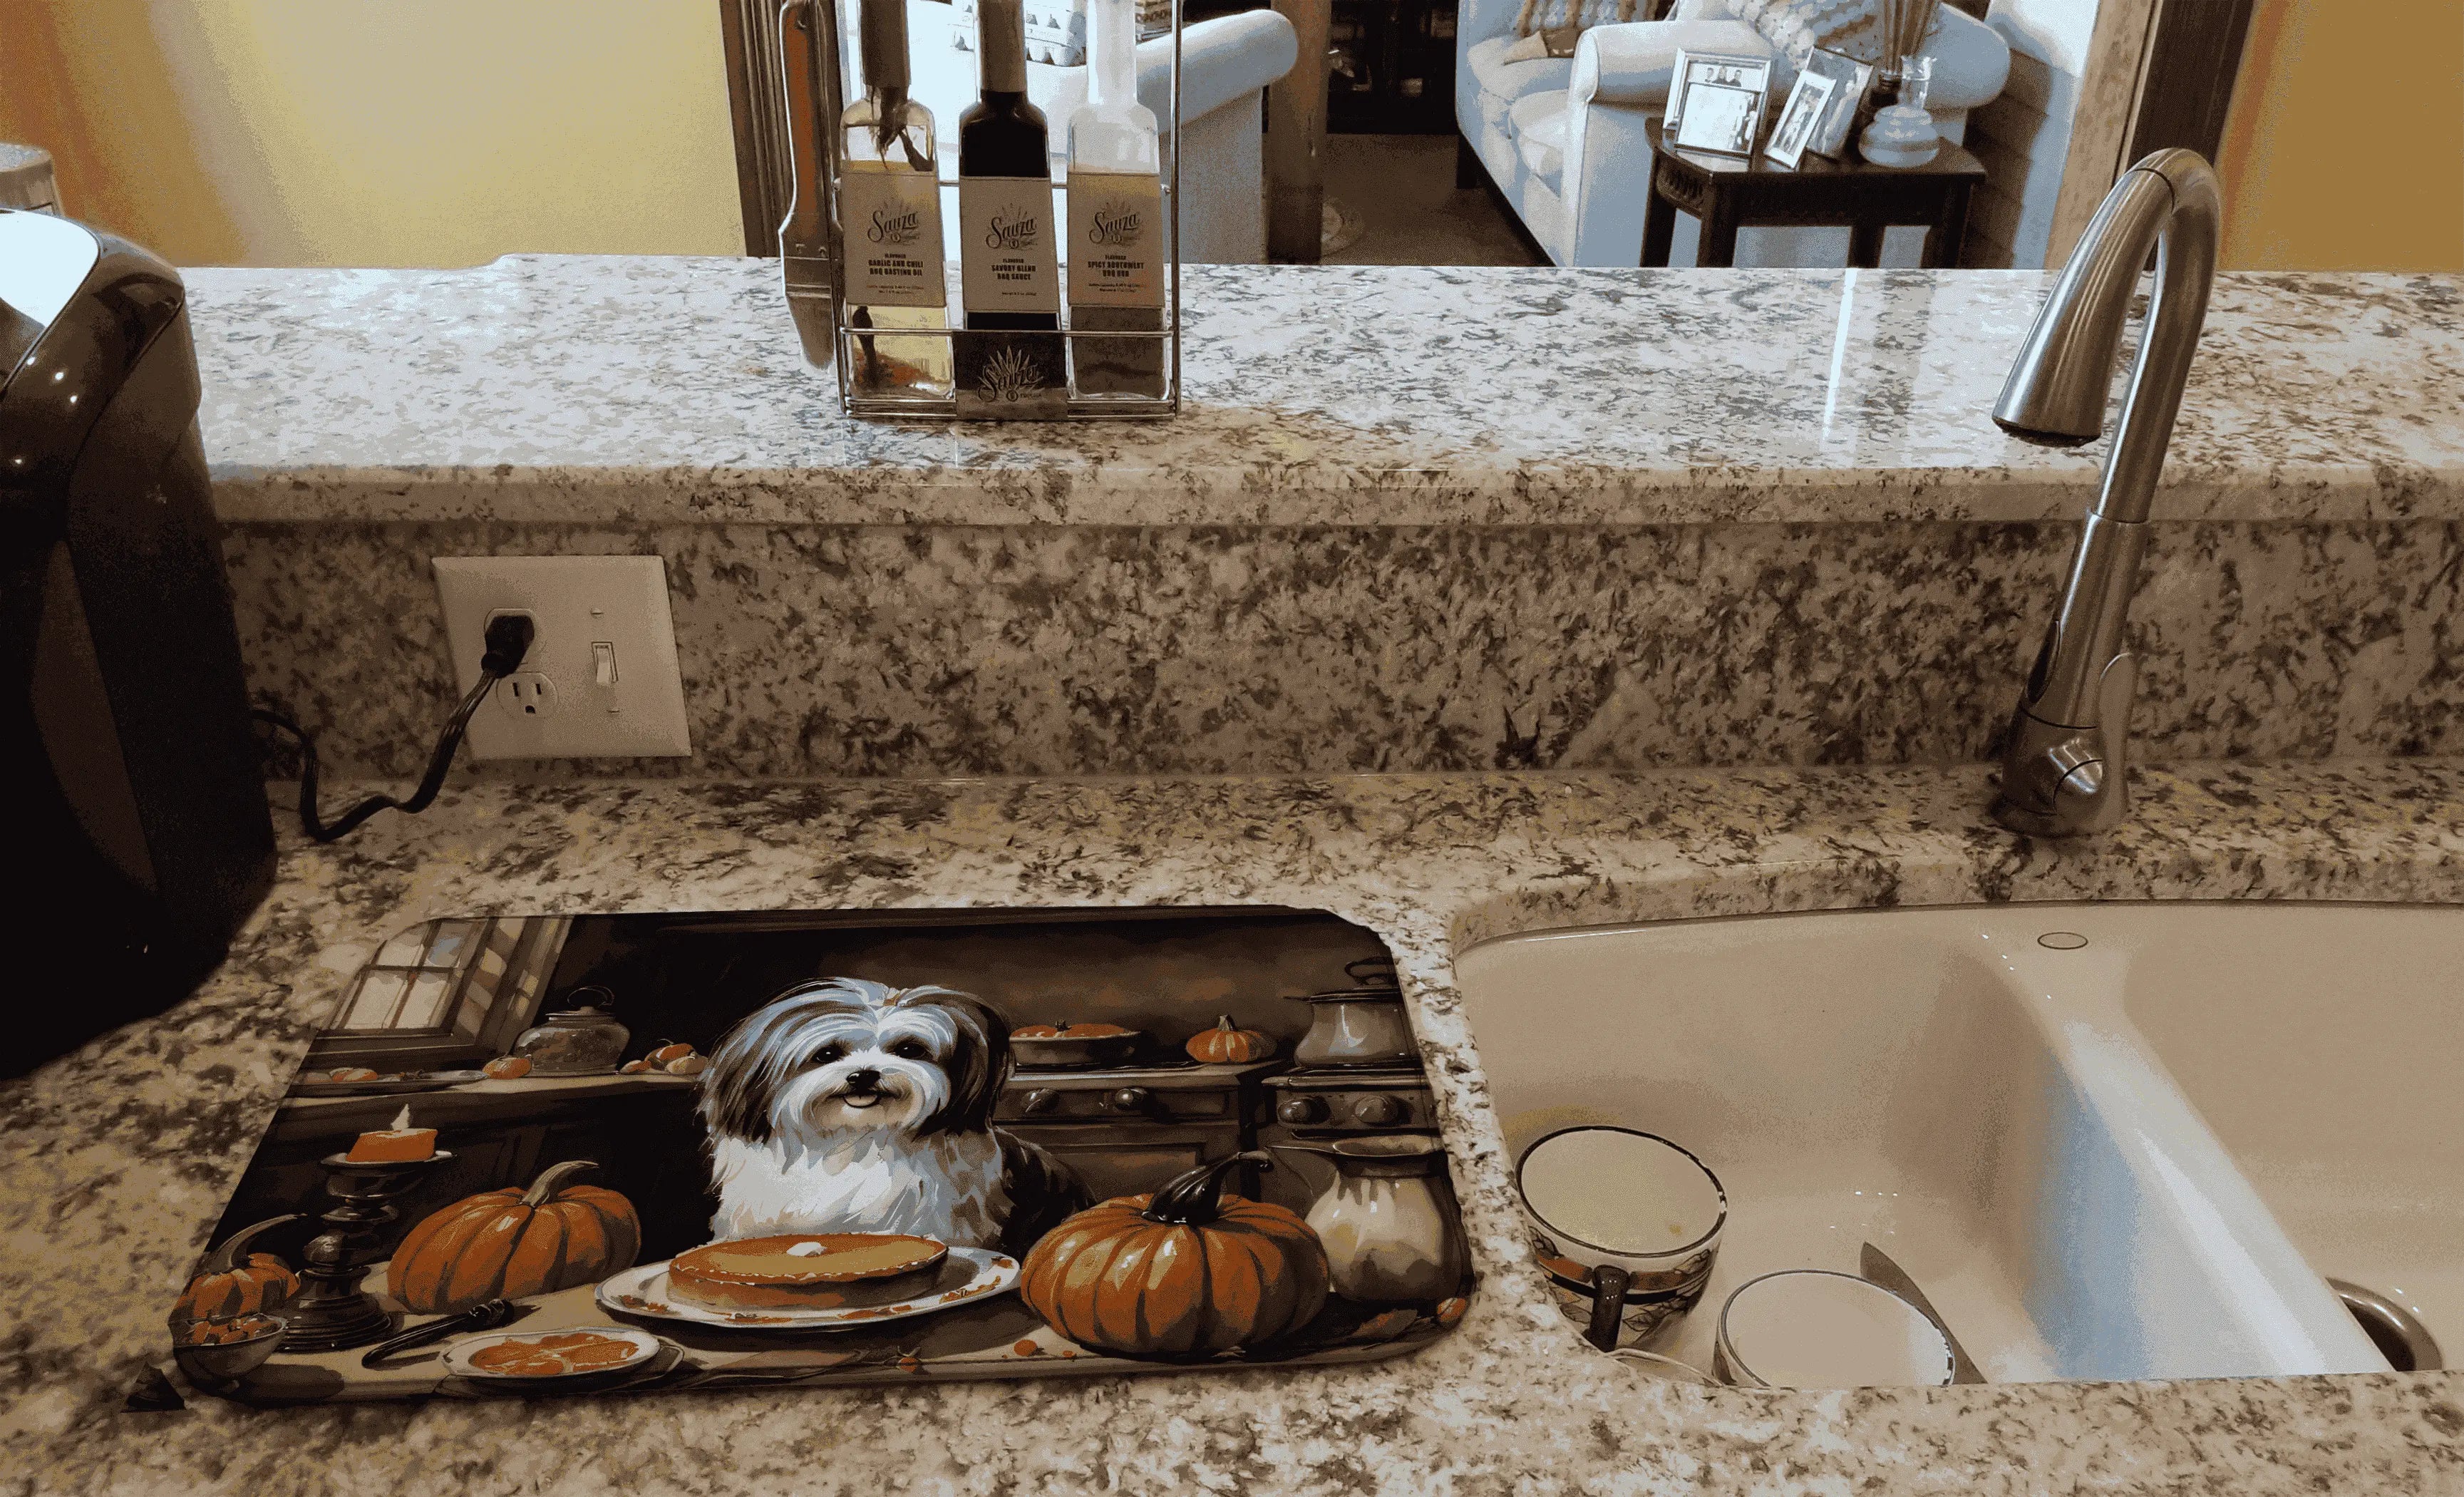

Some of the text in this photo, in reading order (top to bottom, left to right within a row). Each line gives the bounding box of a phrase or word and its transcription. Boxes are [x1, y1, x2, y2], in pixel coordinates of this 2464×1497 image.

[867, 210, 919, 242] Sauza
[986, 217, 1037, 249] Sauza
[1088, 212, 1140, 244] Sauza
